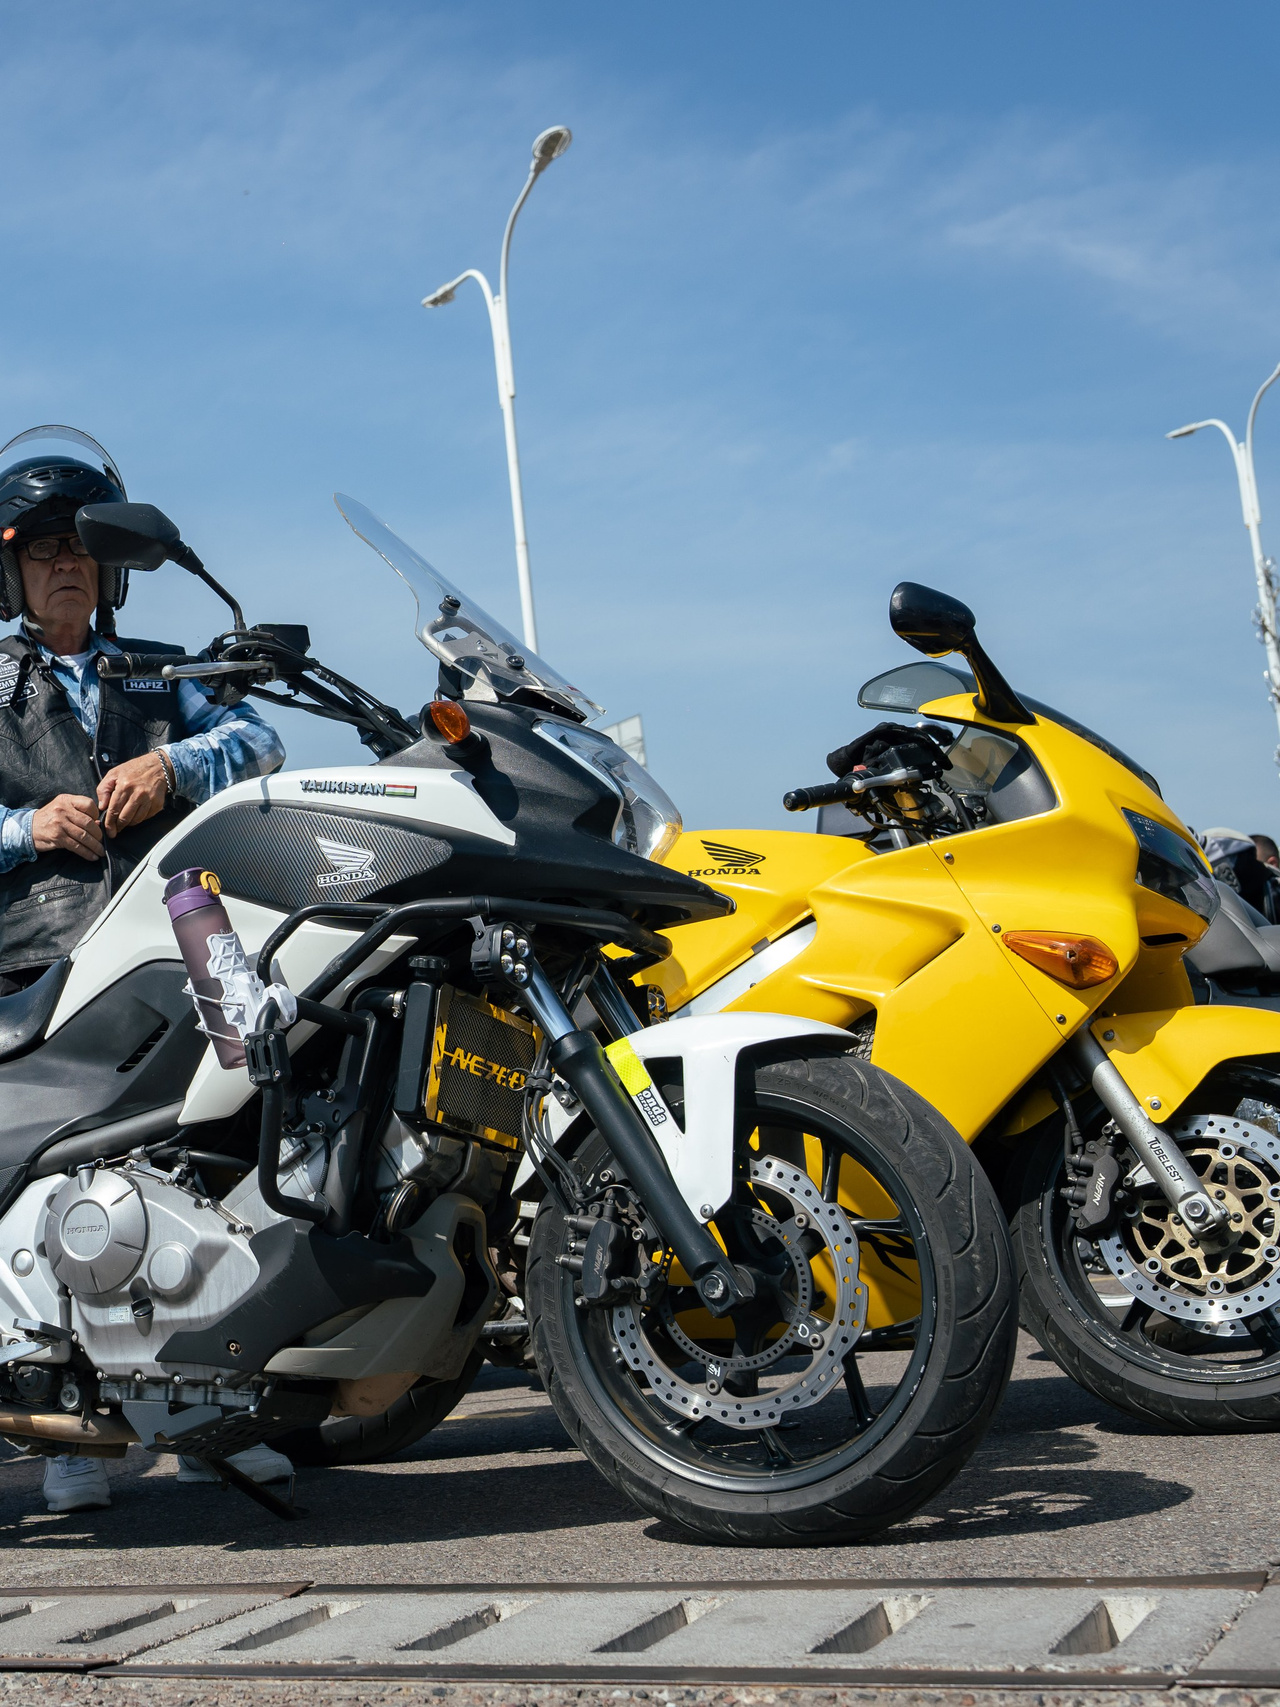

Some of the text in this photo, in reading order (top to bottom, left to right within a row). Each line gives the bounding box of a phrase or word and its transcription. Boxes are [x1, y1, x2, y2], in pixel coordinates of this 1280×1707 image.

[130, 681, 164, 689] HAFIZ
[300, 780, 385, 795] TAJIKISTAN
[318, 870, 375, 885] HONDA
[687, 868, 761, 877] HONDA
[637, 1092, 659, 1126] torsports
[641, 1088, 667, 1123] onda
[1147, 1136, 1185, 1182] TUBELEST
[66, 1225, 106, 1235] HONDA
